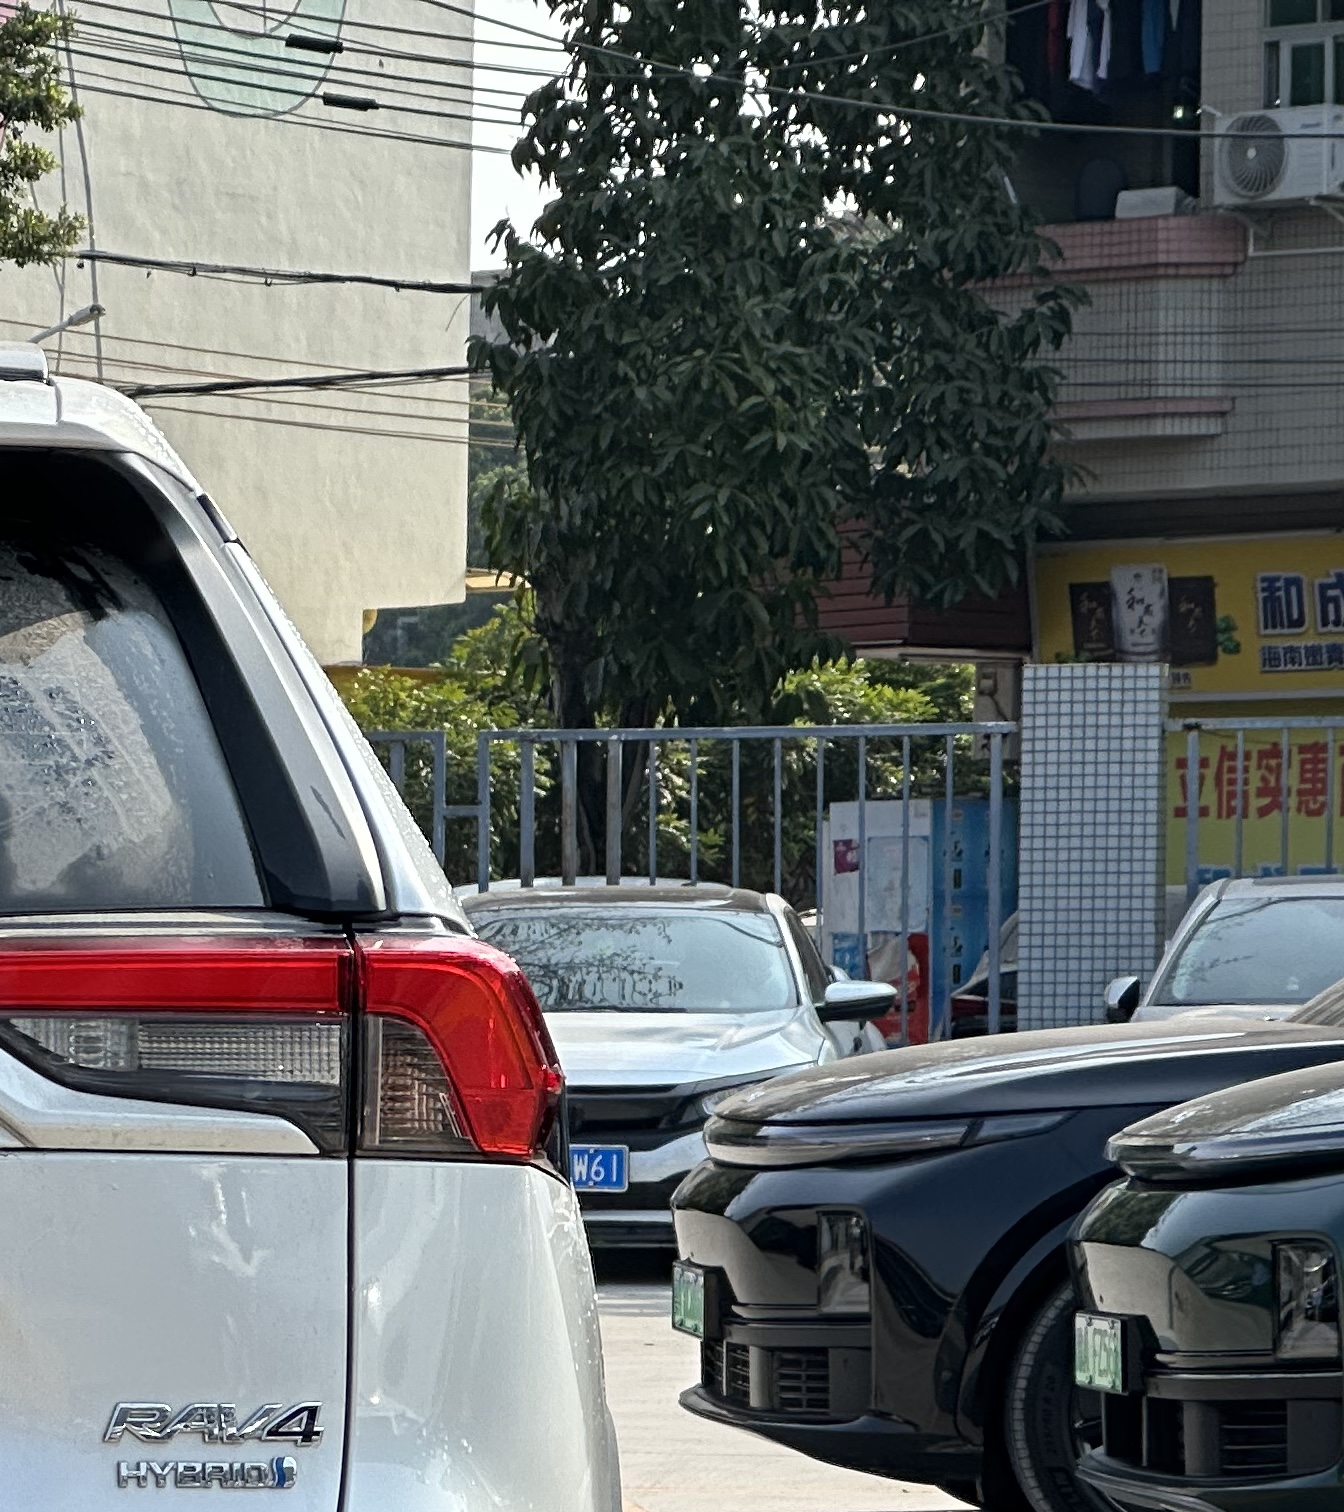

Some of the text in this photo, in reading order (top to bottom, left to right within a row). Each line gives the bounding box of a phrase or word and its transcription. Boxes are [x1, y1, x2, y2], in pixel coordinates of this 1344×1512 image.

[1173, 741, 1344, 819] 立信实惠
[103, 1401, 324, 1447] RAV4
[117, 1459, 271, 1489] HYBRID
